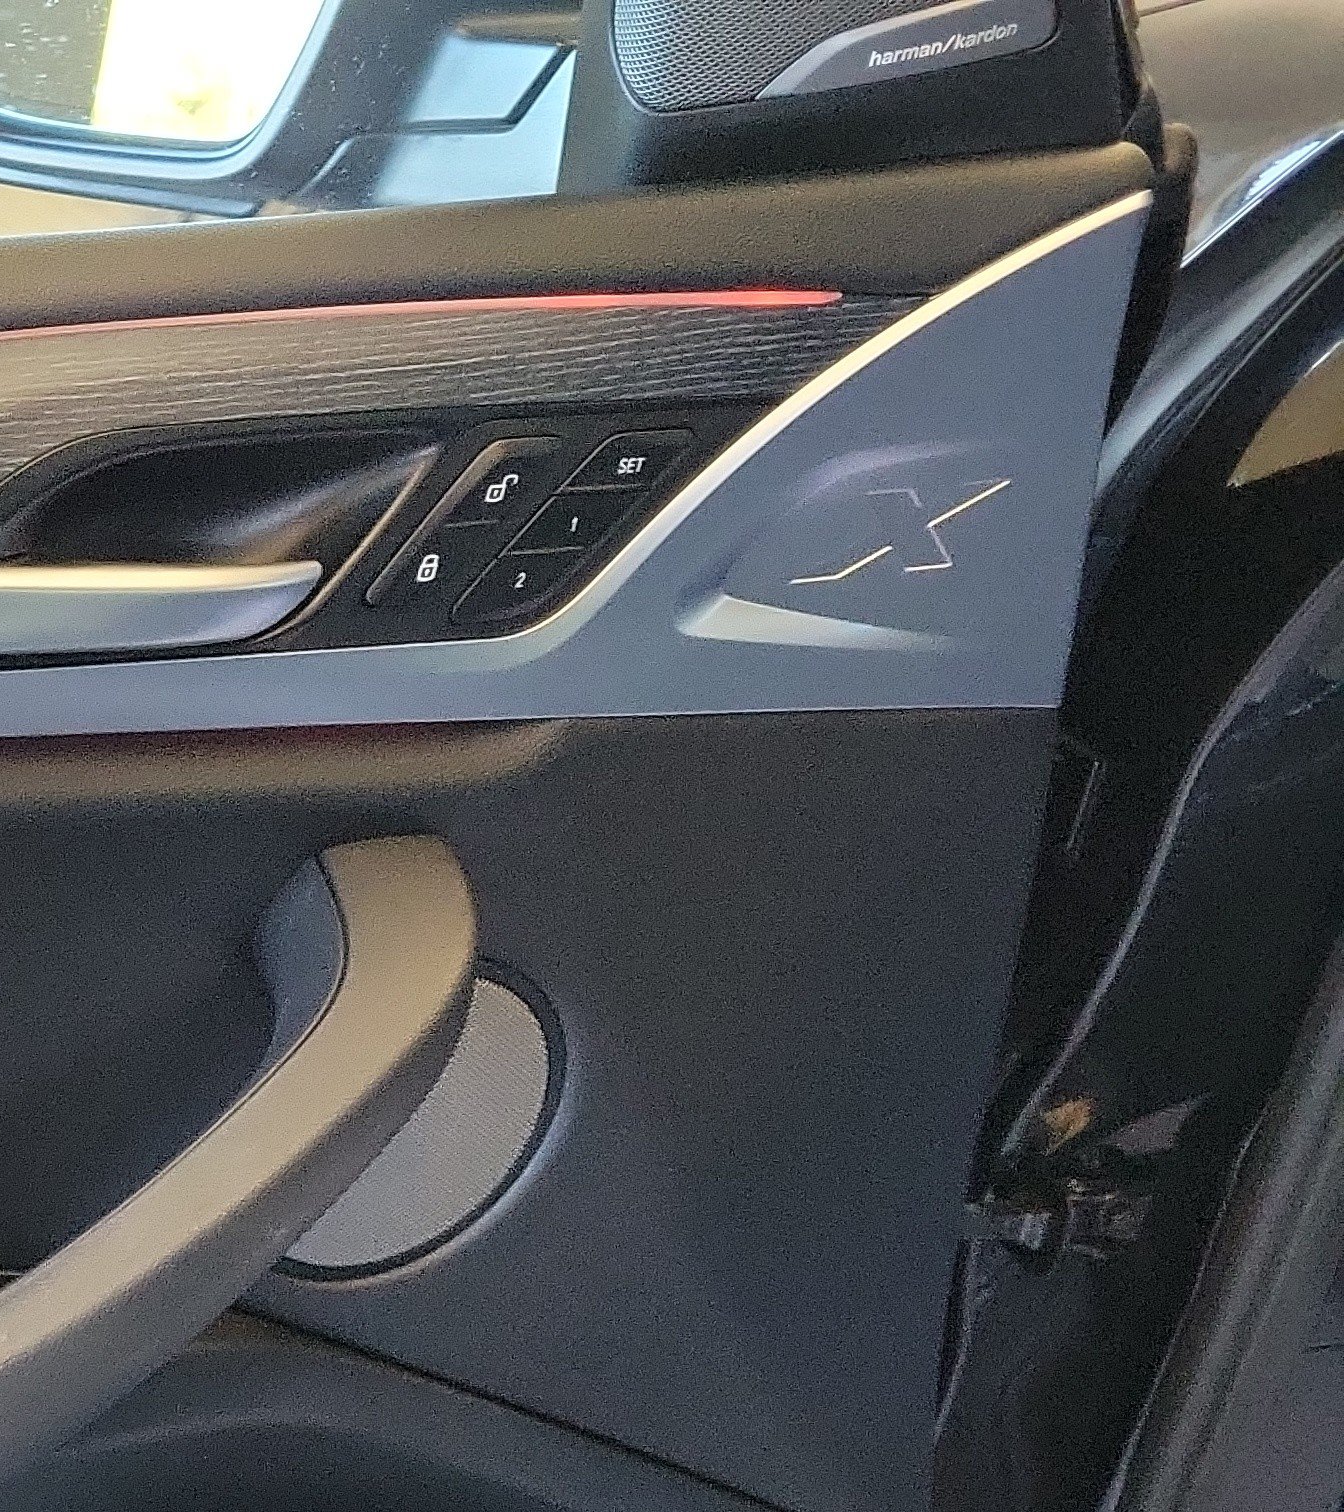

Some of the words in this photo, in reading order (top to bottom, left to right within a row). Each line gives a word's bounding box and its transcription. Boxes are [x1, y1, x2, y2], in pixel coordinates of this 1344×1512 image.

[868, 22, 1018, 67] harman/kardon
[617, 456, 647, 475] SET
[569, 516, 579, 533] 1
[514, 571, 527, 589] 2
